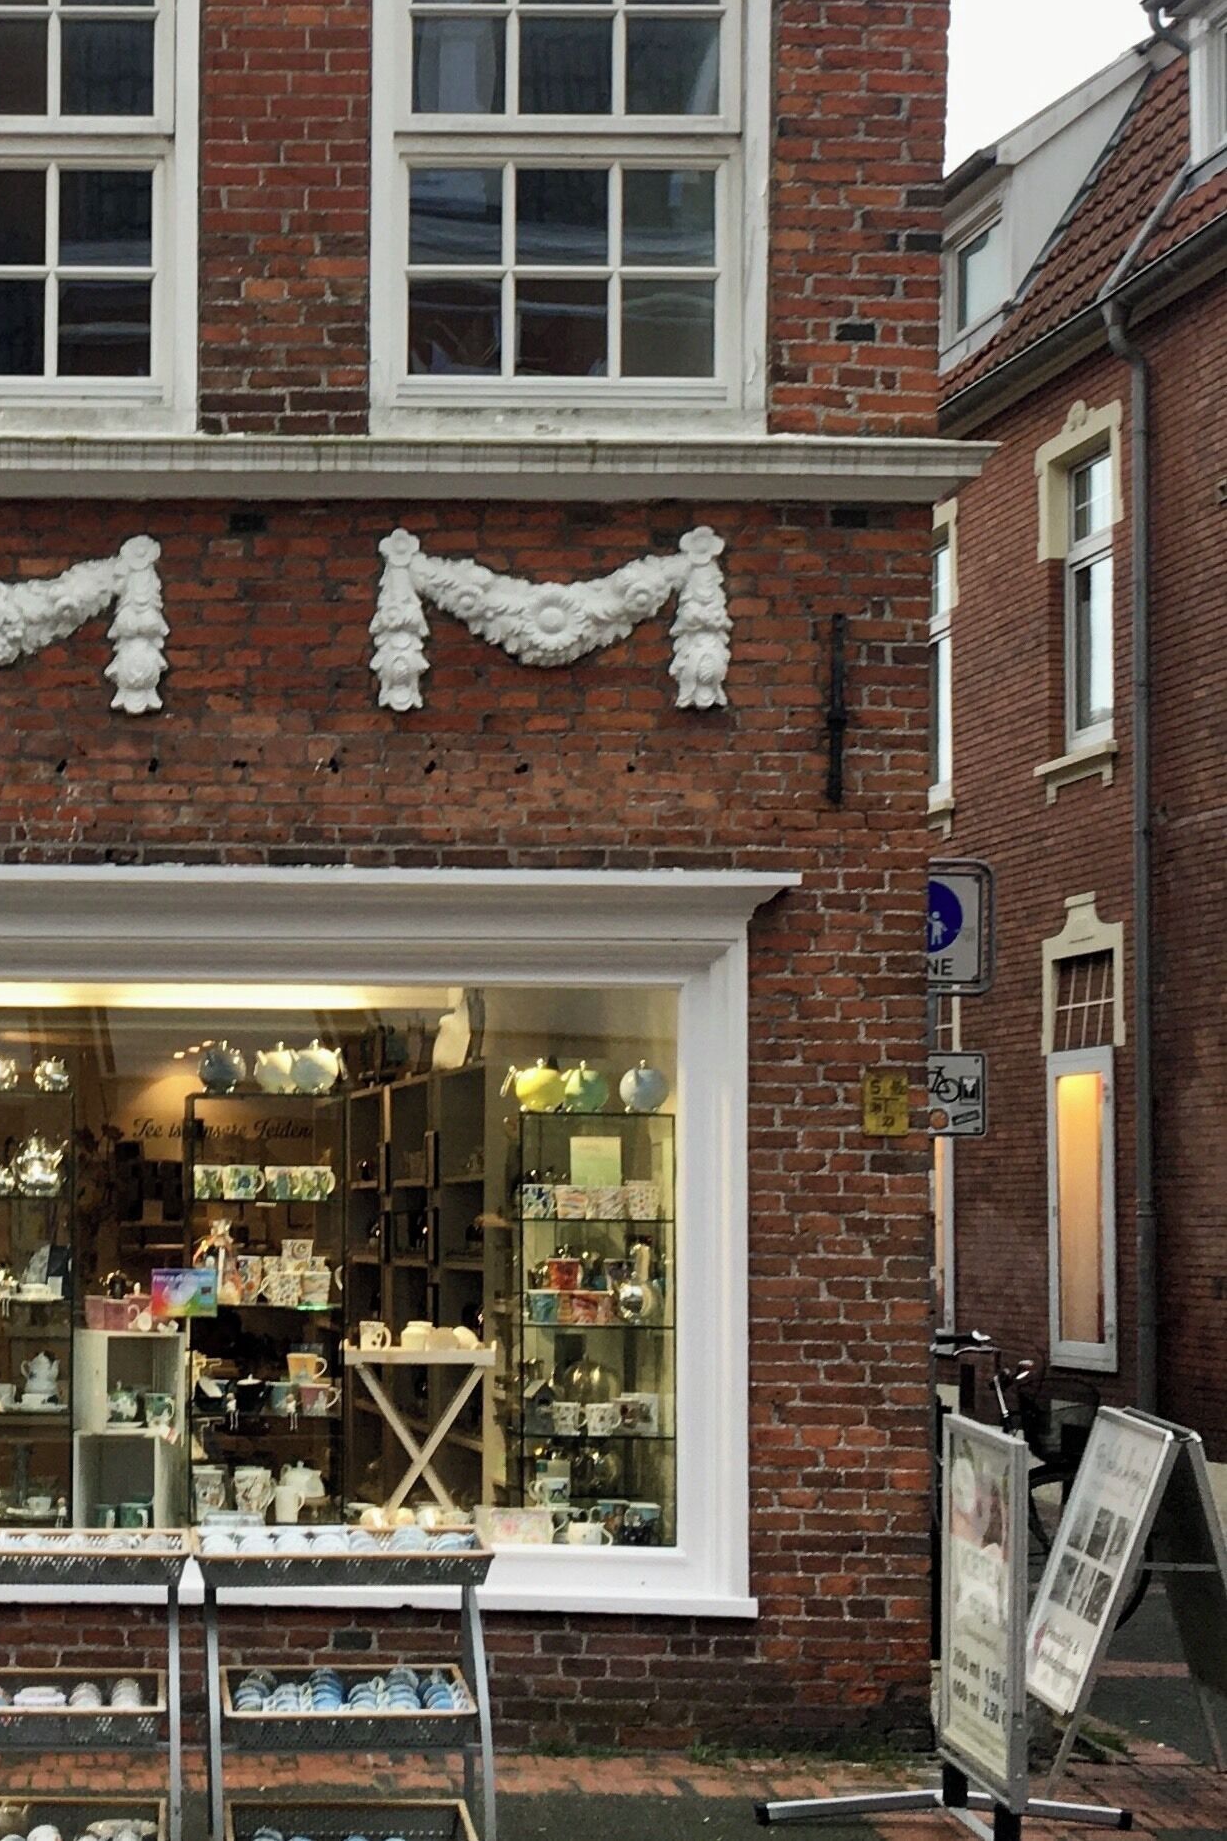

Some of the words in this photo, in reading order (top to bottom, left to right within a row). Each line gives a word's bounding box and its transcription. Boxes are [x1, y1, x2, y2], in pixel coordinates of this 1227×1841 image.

[928, 958, 954, 976] NE
[132, 1118, 163, 1138] Tee
[168, 1122, 182, 1138] is
[203, 1125, 248, 1139] nsere
[254, 1118, 312, 1139] Leiden
